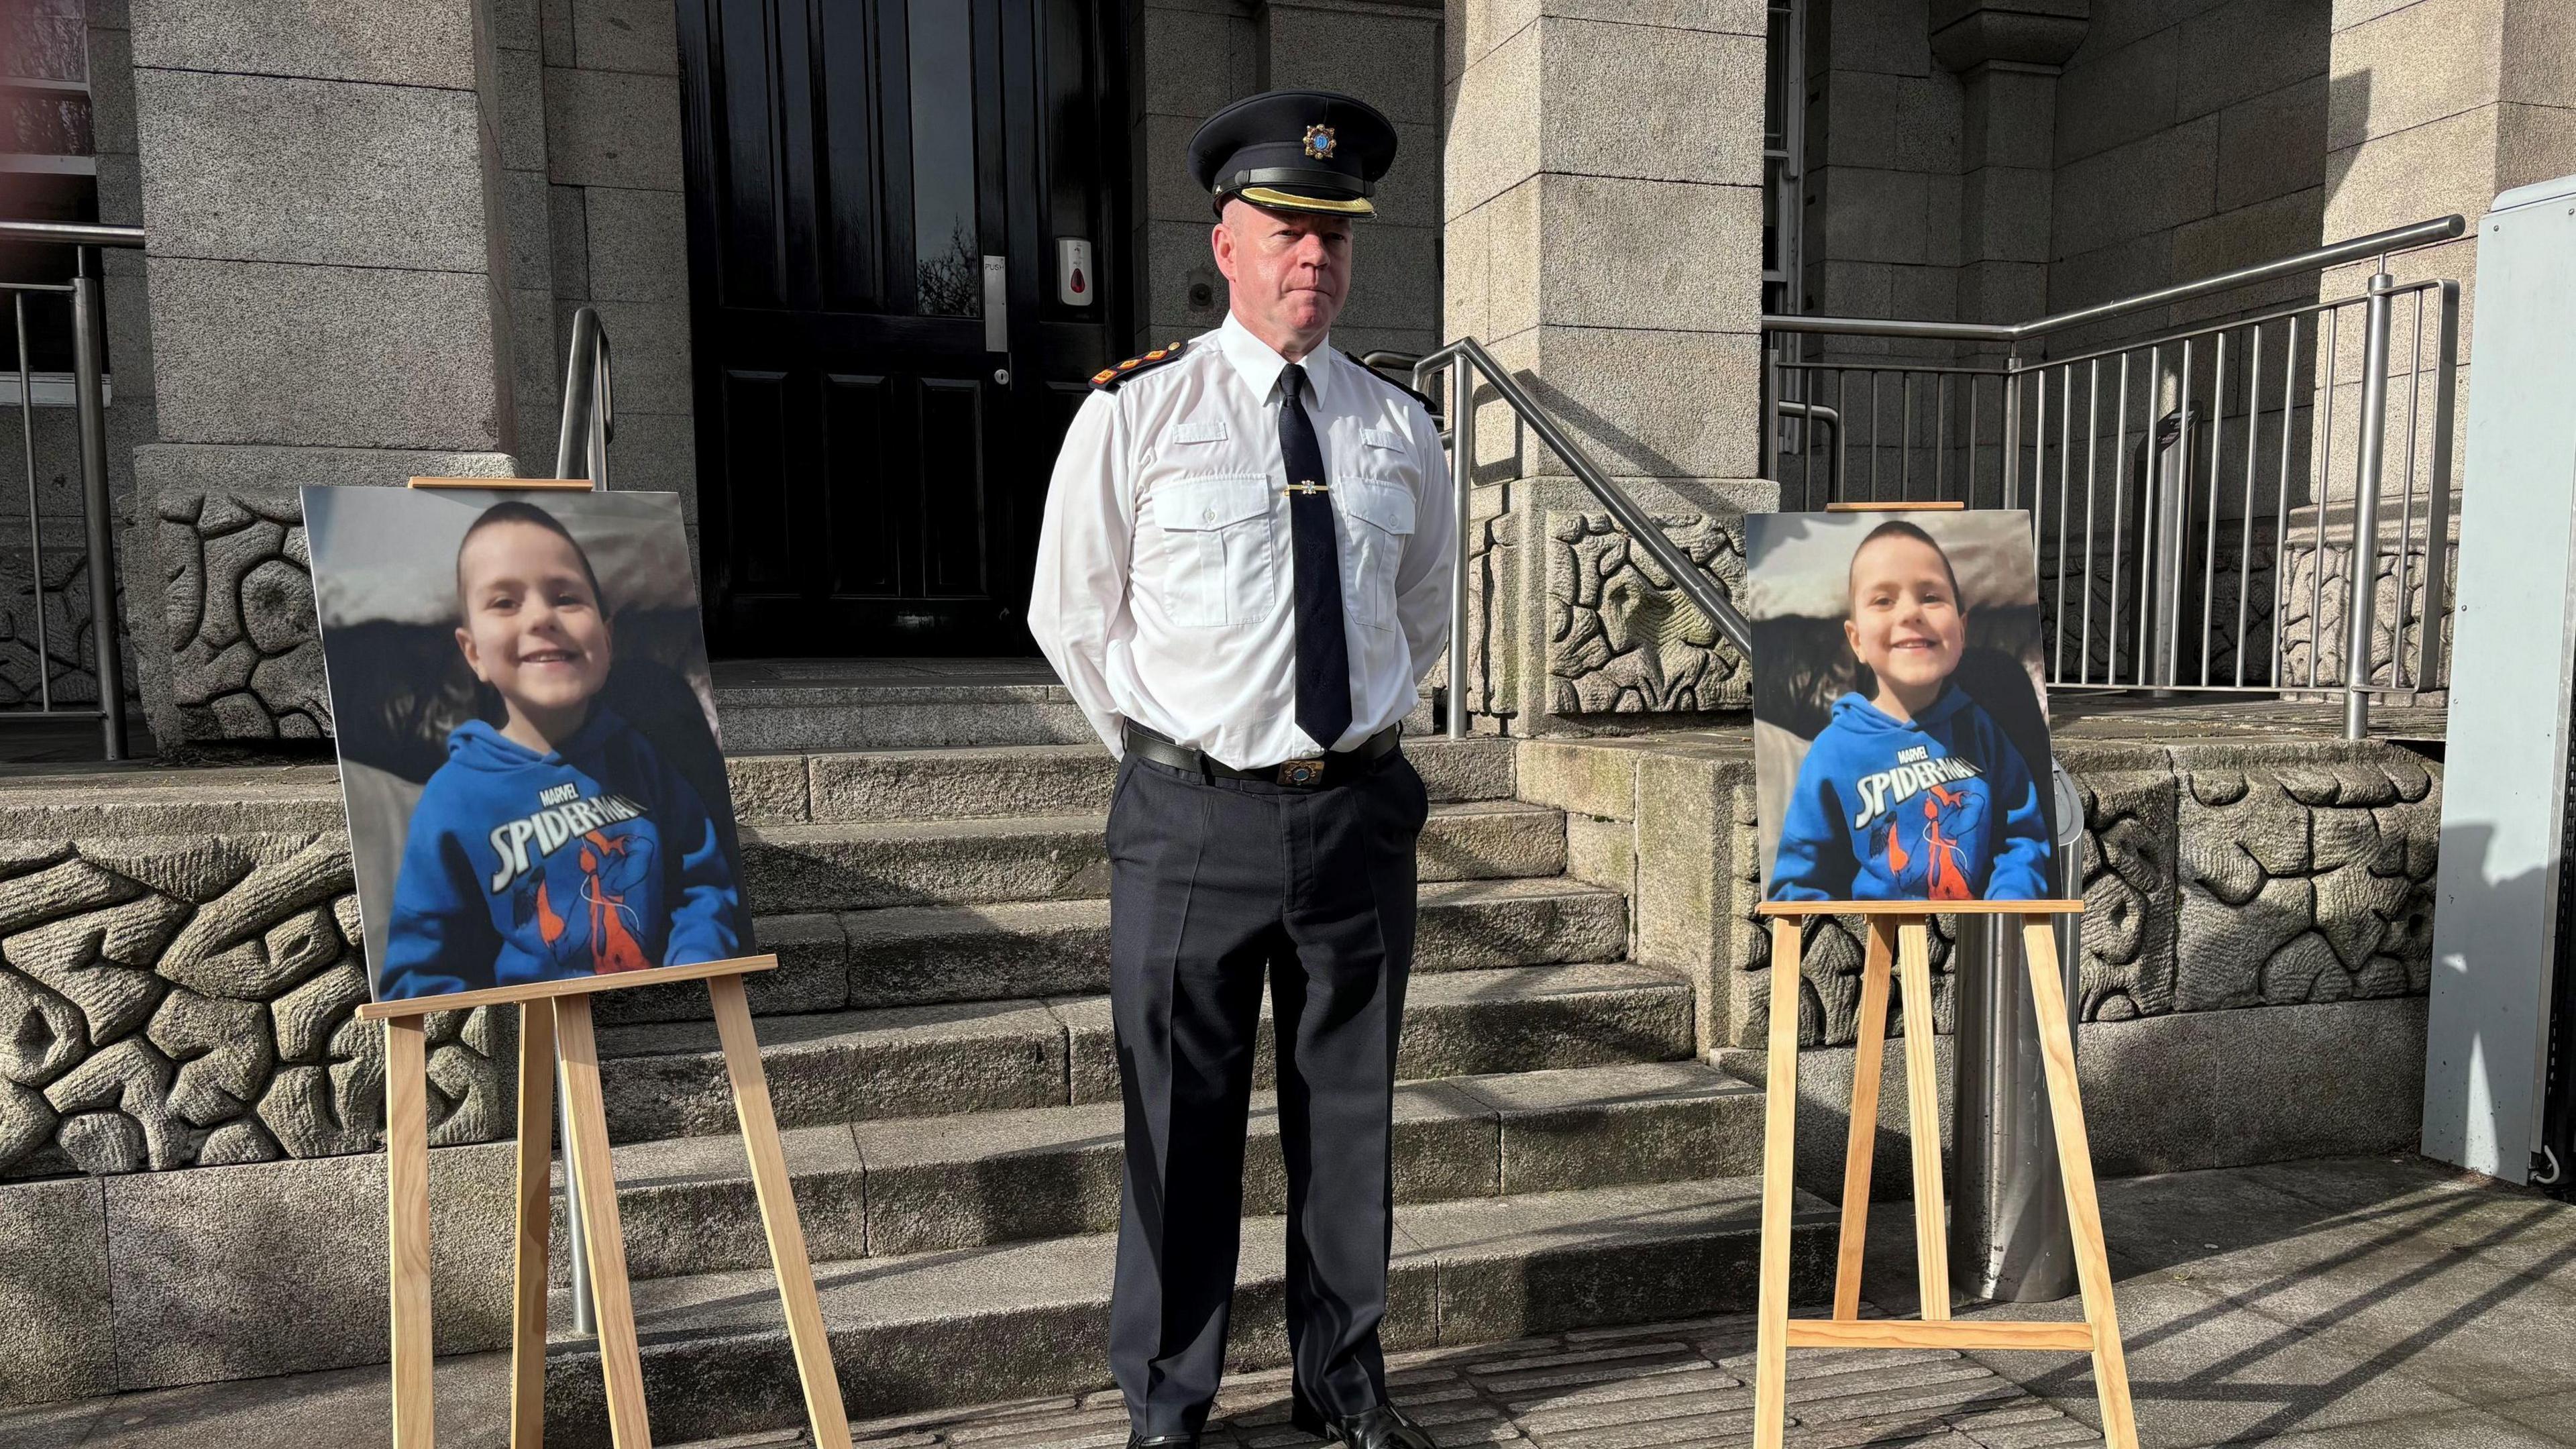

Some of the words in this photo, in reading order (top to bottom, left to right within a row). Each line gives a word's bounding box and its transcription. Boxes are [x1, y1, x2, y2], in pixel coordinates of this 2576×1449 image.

[985, 263, 1004, 271] PUSH
[1898, 745, 1928, 764] MARVEL
[540, 783, 579, 806] MARVEL
